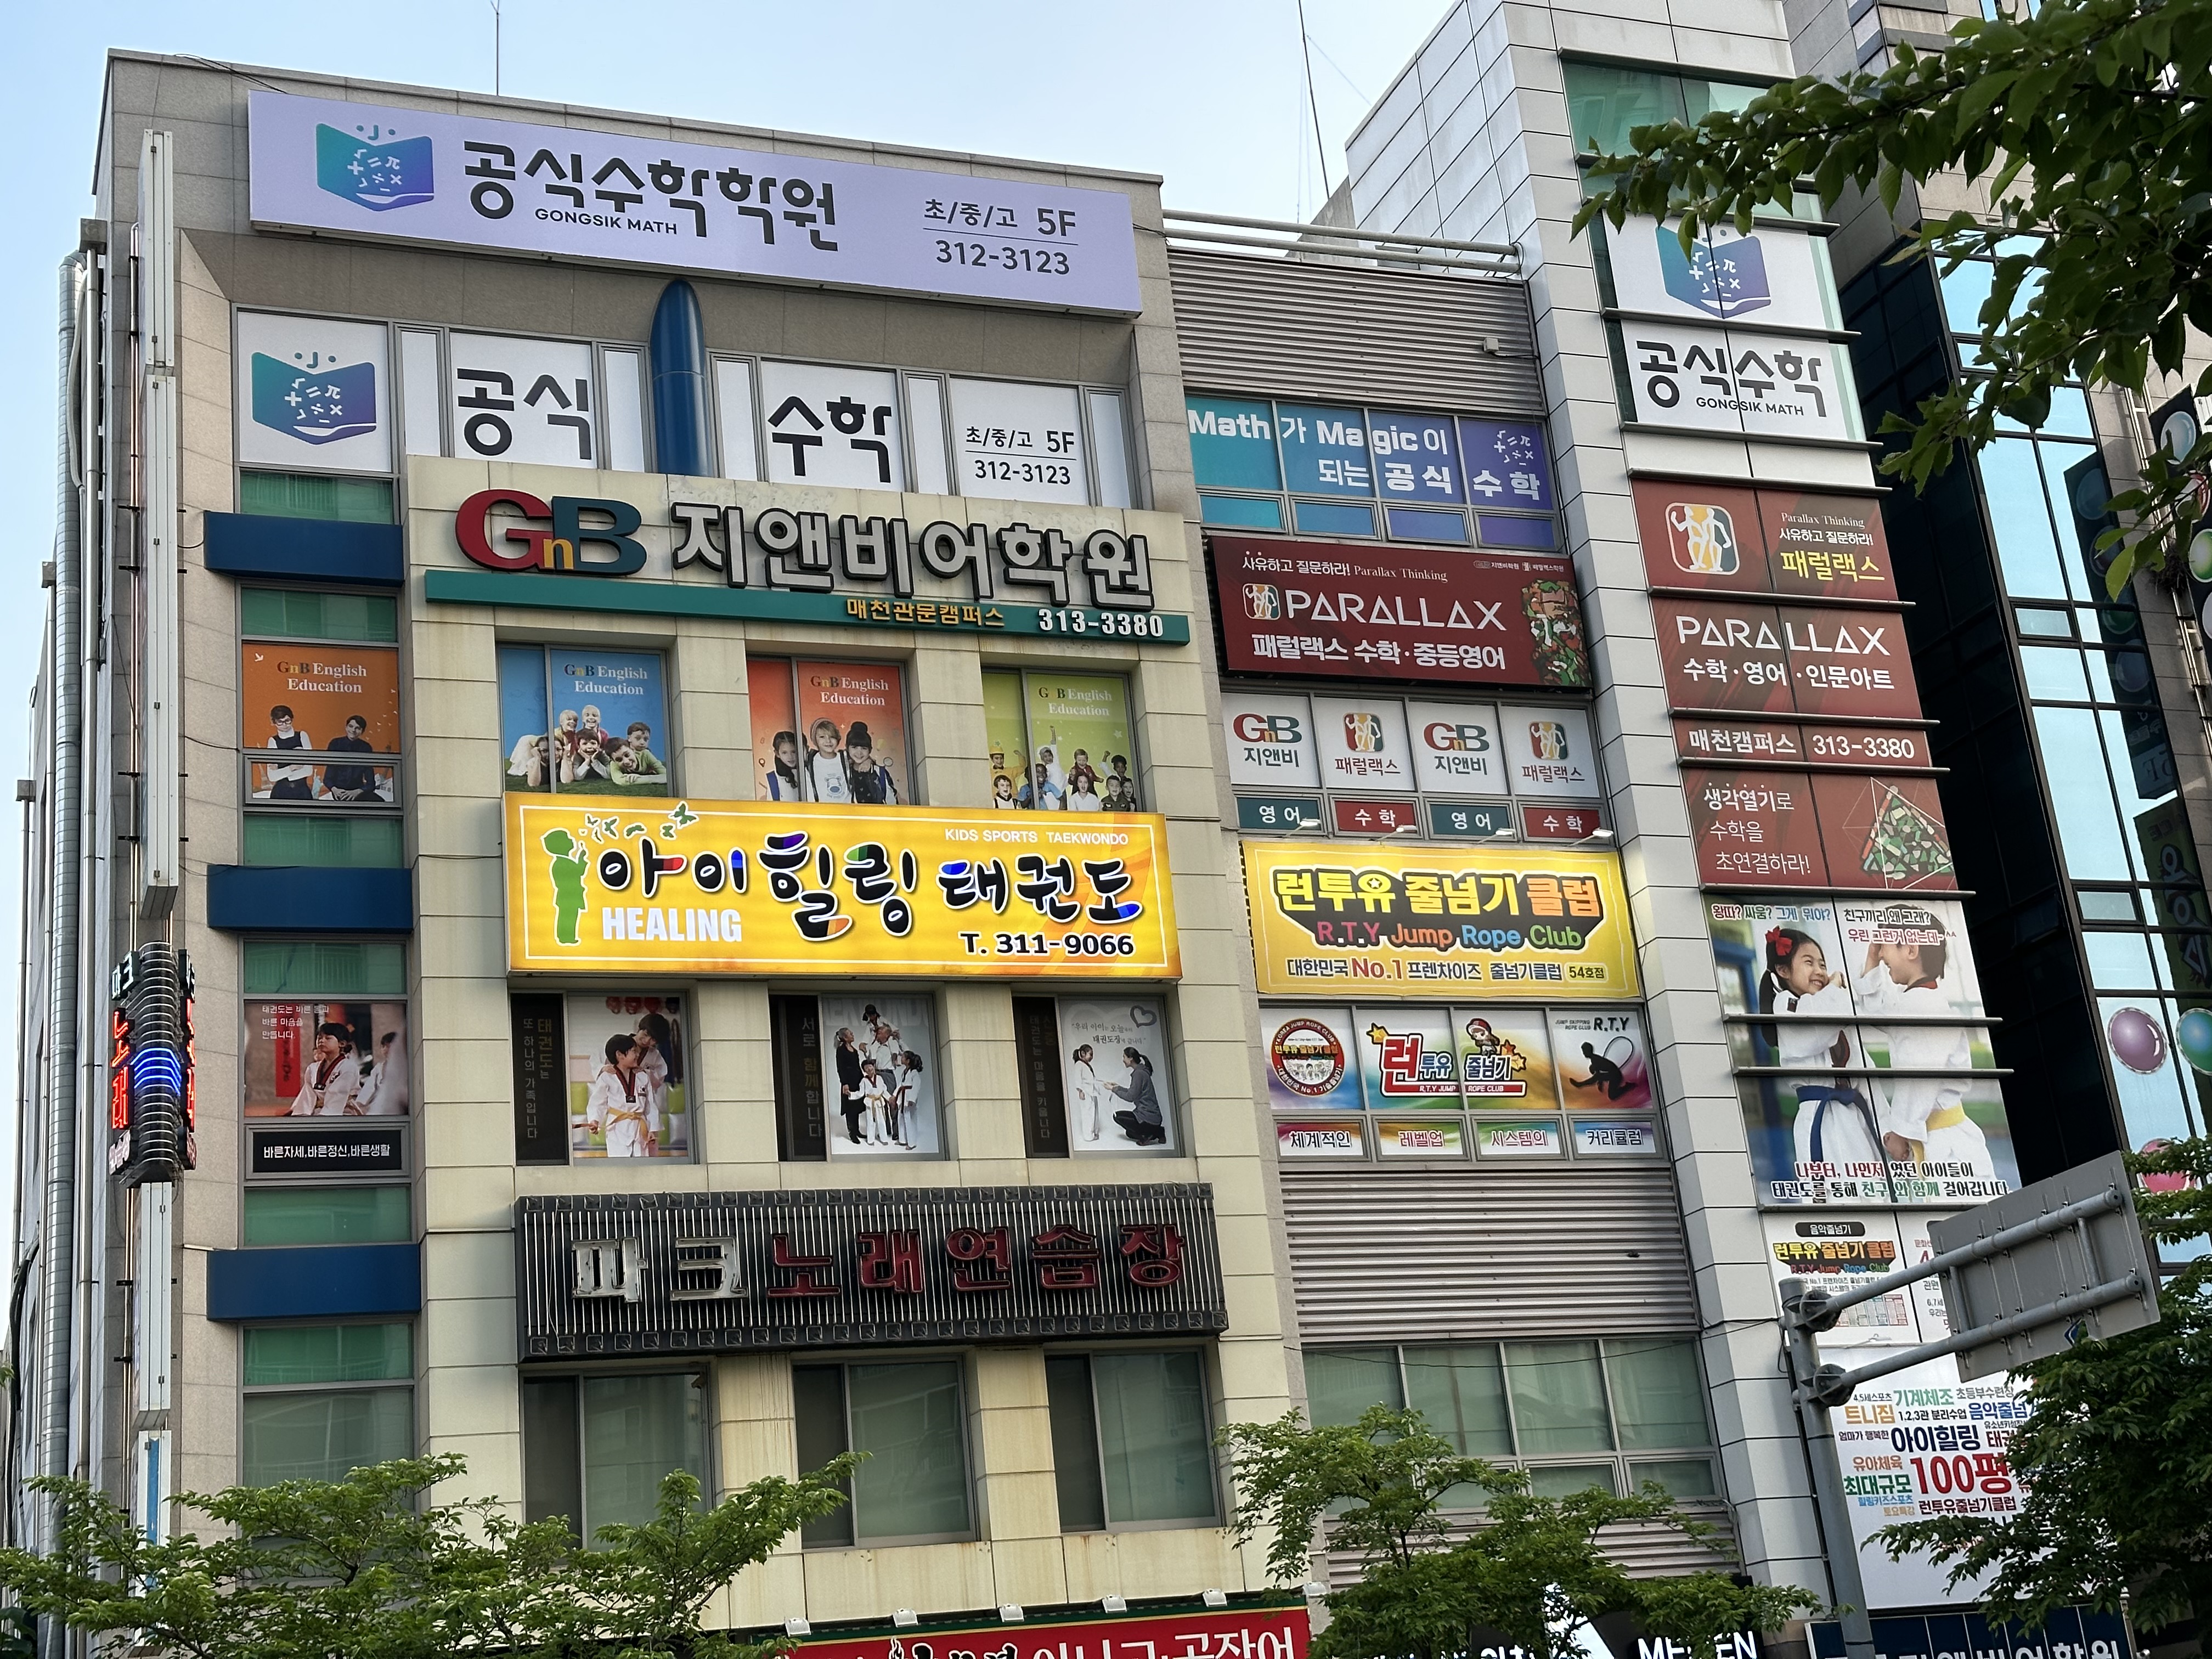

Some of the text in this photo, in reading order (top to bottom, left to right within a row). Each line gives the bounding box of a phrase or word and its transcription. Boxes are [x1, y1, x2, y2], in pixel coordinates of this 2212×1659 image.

[464, 140, 838, 251] 공식수학학원
[534, 207, 678, 235] GONGSIK MATH
[924, 198, 1076, 237] 초/중/고 5F
[936, 239, 1070, 275] 312-3123
[1636, 341, 1827, 417] 공식수학
[1696, 397, 1804, 416] GONGSIK MATH
[456, 368, 892, 483] 공식 수학
[966, 425, 1075, 453] 초/중/고 5F
[974, 459, 1071, 484] 312-3123
[1319, 459, 1369, 487] 되는
[1781, 512, 1865, 529] Parallax Thinking
[1780, 528, 1873, 546] 사유하고 질문하라!
[455, 489, 1154, 611] GnB 지앤비어학원
[1242, 551, 1448, 583] 사유하고 질문하라! Parallax Thinking
[1781, 551, 1885, 582] 패럴랙스
[847, 598, 1164, 637] 매천관문캠퍼스 313-3380
[1285, 590, 1507, 630] PARALLAX
[1676, 616, 1891, 656] PARALLAX
[1251, 634, 1349, 659] 패럴랙스
[277, 662, 366, 678] GnB English
[565, 664, 648, 680] GnB English
[287, 678, 363, 693] Education
[574, 681, 644, 695] Education
[810, 675, 889, 692] GnB English
[820, 692, 885, 706] Education
[1068, 689, 1113, 702] English
[1048, 703, 1110, 716] Education
[1233, 713, 1302, 743] GnB
[1424, 722, 1489, 752] GnB
[1689, 730, 1915, 758] 매천캠퍼스 313-3380
[1244, 747, 1300, 768] 지앤비
[1335, 757, 1401, 776] 패럴랙스
[1434, 756, 1487, 775] 지앤비
[1522, 765, 1585, 783] 패럴랙스
[1703, 788, 1794, 812] 생각열기로
[1259, 806, 1301, 823] 영어
[1355, 809, 1396, 828] 수학
[1451, 812, 1491, 831] 영어
[1543, 815, 1582, 833] 수학
[945, 828, 1128, 845] KIDS SPORTS TAEKWONDO
[1709, 820, 1764, 843] 수학을
[1716, 851, 1811, 875] 초연결하라!
[935, 853, 1143, 923] 태권도
[1276, 871, 1600, 917] 런투유 줄넘기 클럽
[1713, 905, 1830, 921] 왕따? 싸움? 그게 뭐야?
[1844, 909, 1931, 926] 친구끼리 왜 그래?
[602, 906, 742, 943] HEALING
[958, 932, 1135, 956] T. 311-9066
[1318, 921, 1581, 951] R.T.Y Jump Rope Club
[1848, 929, 1869, 943] 우린
[1873, 929, 1904, 943] 그런거
[1286, 957, 1605, 981] 대한민국 No.1 프렌차이즈 줄넘기클럽 54호점
[1593, 1017, 1629, 1031] R.T.Y
[1466, 1055, 1512, 1079] 줄넘기
[1290, 1131, 1352, 1148] 체계적인
[1398, 1130, 1445, 1147] 레벨업
[1491, 1130, 1548, 1147] 시스템의
[1587, 1128, 1643, 1146] 커리큘럼
[1795, 1162, 1841, 1178] 나부터,
[1922, 1163, 1973, 1177] 아이들이
[1772, 1182, 1826, 1198] 태권도를
[1830, 1182, 1858, 1198] 통해
[1913, 1182, 1940, 1197] 함께
[1810, 1224, 1851, 1234] 음악줄넘기
[1774, 1242, 1895, 1260] 런투유 줄넘기 클럽
[1818, 1264, 1841, 1274] Jump
[1844, 1263, 1866, 1274] Rope
[1870, 1263, 1889, 1272] Club
[1893, 1388, 1955, 1407] 기계체조
[1956, 1386, 2014, 1400] 초등부수련장
[1844, 1404, 1896, 1425] 트니짐
[1931, 1408, 1967, 1420] 분리수업
[1839, 1425, 1981, 1453] 엄마가 행복한 아이힐링
[1853, 1455, 1903, 1472] 유아체육
[1843, 1453, 2012, 1496] 최대규모 100평
[1858, 1496, 1913, 1506] 힐링키즈스포츠
[1918, 1497, 2017, 1515] 런투유줄넘기클럽
